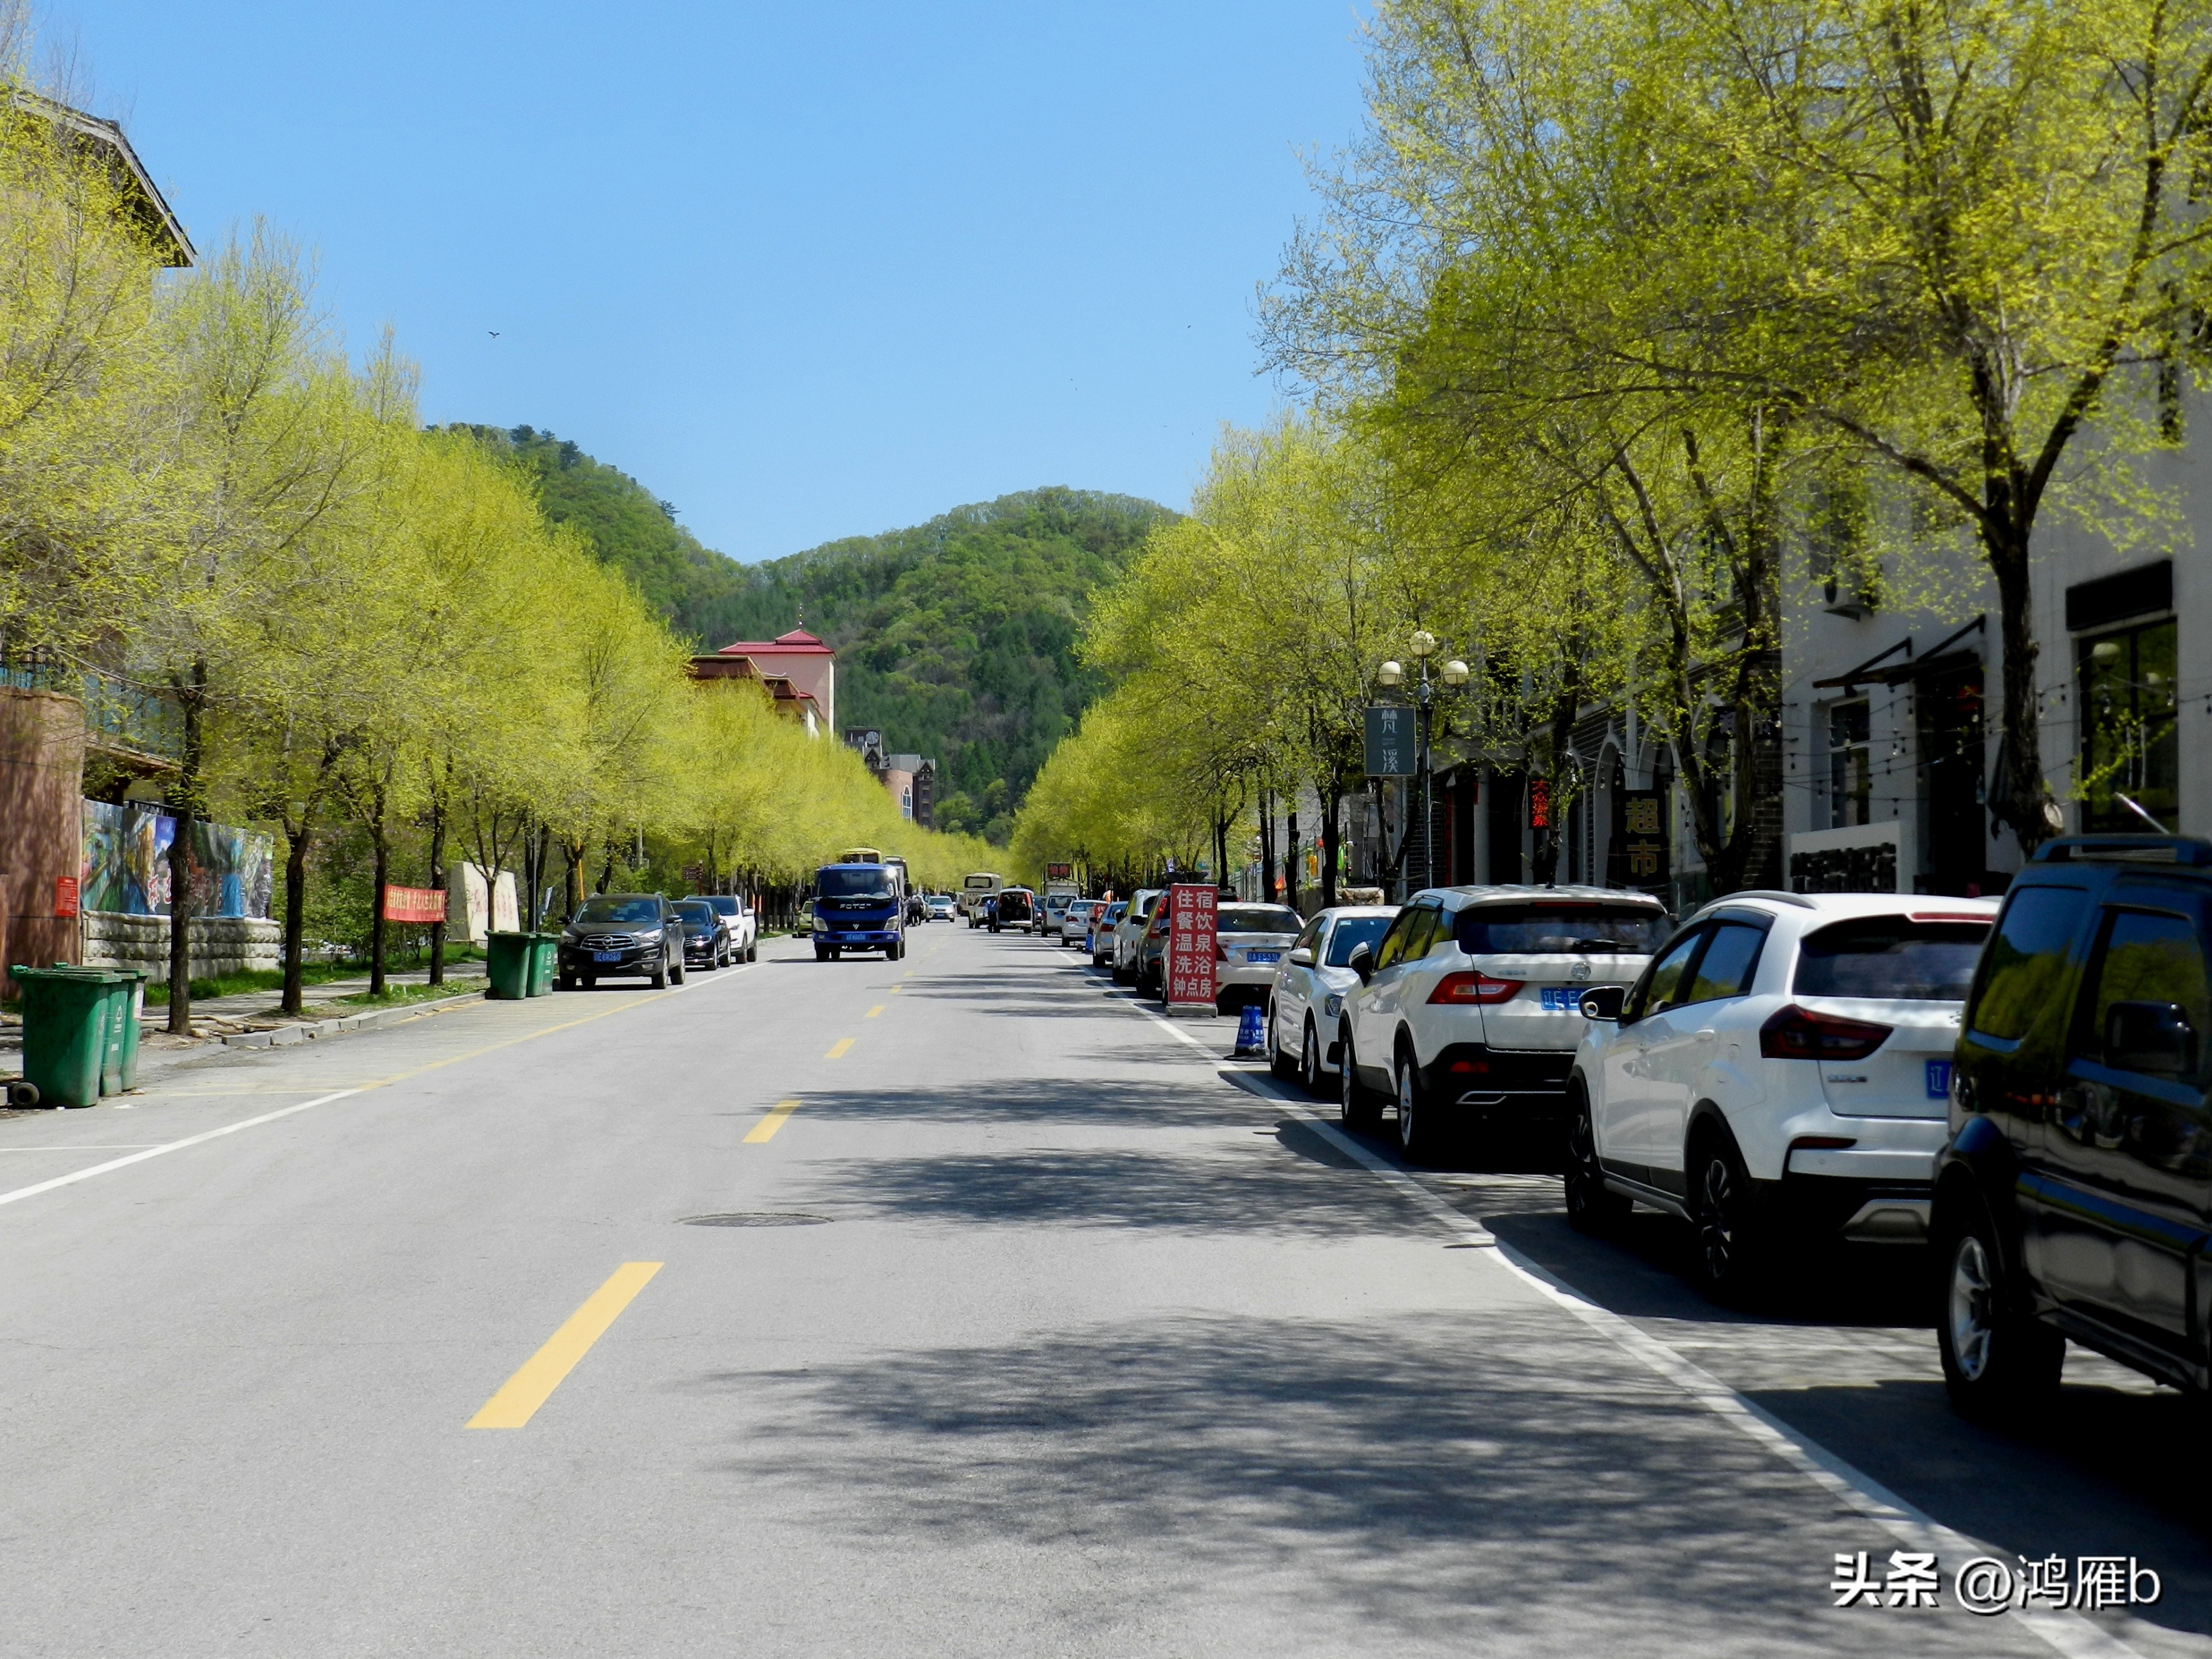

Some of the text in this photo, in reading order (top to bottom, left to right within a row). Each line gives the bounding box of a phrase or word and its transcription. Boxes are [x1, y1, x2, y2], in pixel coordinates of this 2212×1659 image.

[1625, 797, 1660, 877] 超市
[1177, 889, 1213, 909] 住宿
[1176, 911, 1213, 931] 餐饮
[1175, 933, 1212, 953] 温泉
[1174, 955, 1212, 974] 洗浴
[1173, 976, 1212, 998] 钟点房
